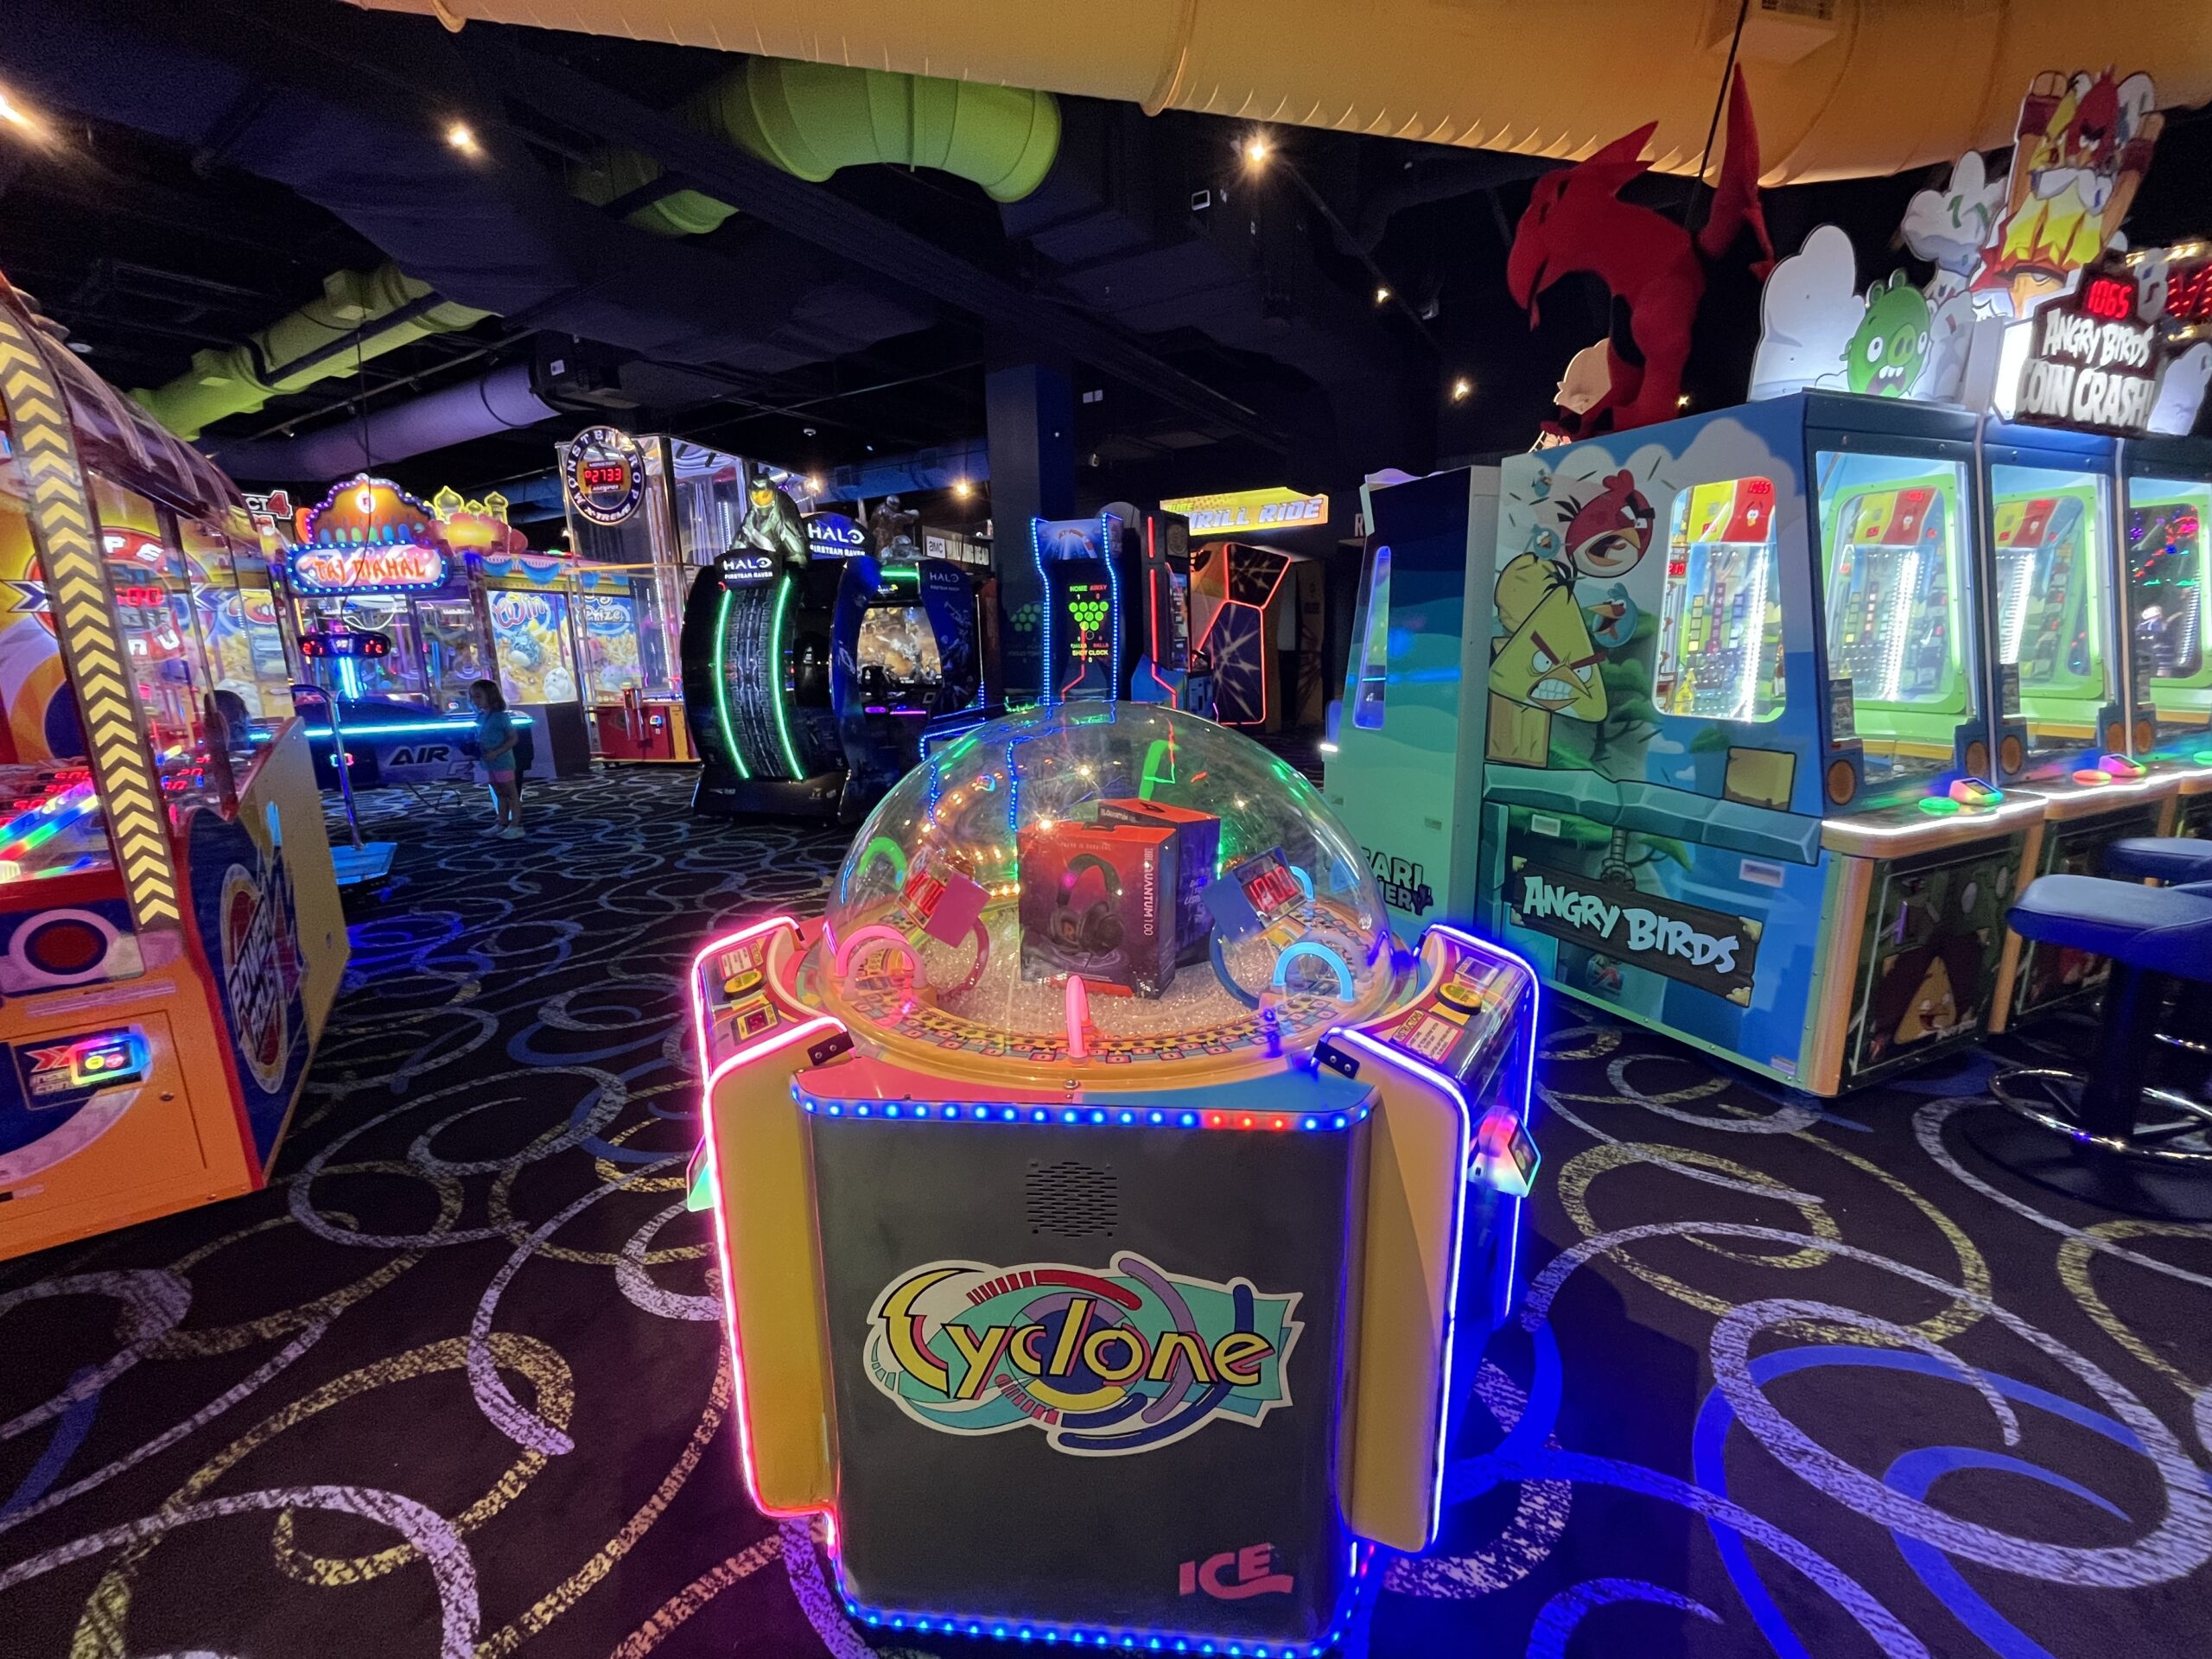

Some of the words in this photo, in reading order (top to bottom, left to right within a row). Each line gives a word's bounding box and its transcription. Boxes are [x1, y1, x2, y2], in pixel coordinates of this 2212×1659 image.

[2087, 278, 2133, 319] 1065
[2041, 308, 2101, 364] ANGRY
[2099, 322, 2154, 368] BIRDS
[2015, 357, 2075, 417] COIN
[1258, 498, 1324, 524] RIDE
[807, 523, 866, 544] HALO
[314, 560, 346, 585] TAJ
[353, 557, 427, 584] MAHAL
[722, 556, 772, 571] HALO
[492, 593, 546, 629] Win
[390, 746, 449, 766] AIR
[1522, 875, 1621, 939] ANGRY
[1622, 908, 1740, 974] BIRDS
[878, 1268, 1277, 1400] Cyclone
[1179, 1542, 1294, 1600] ICE
